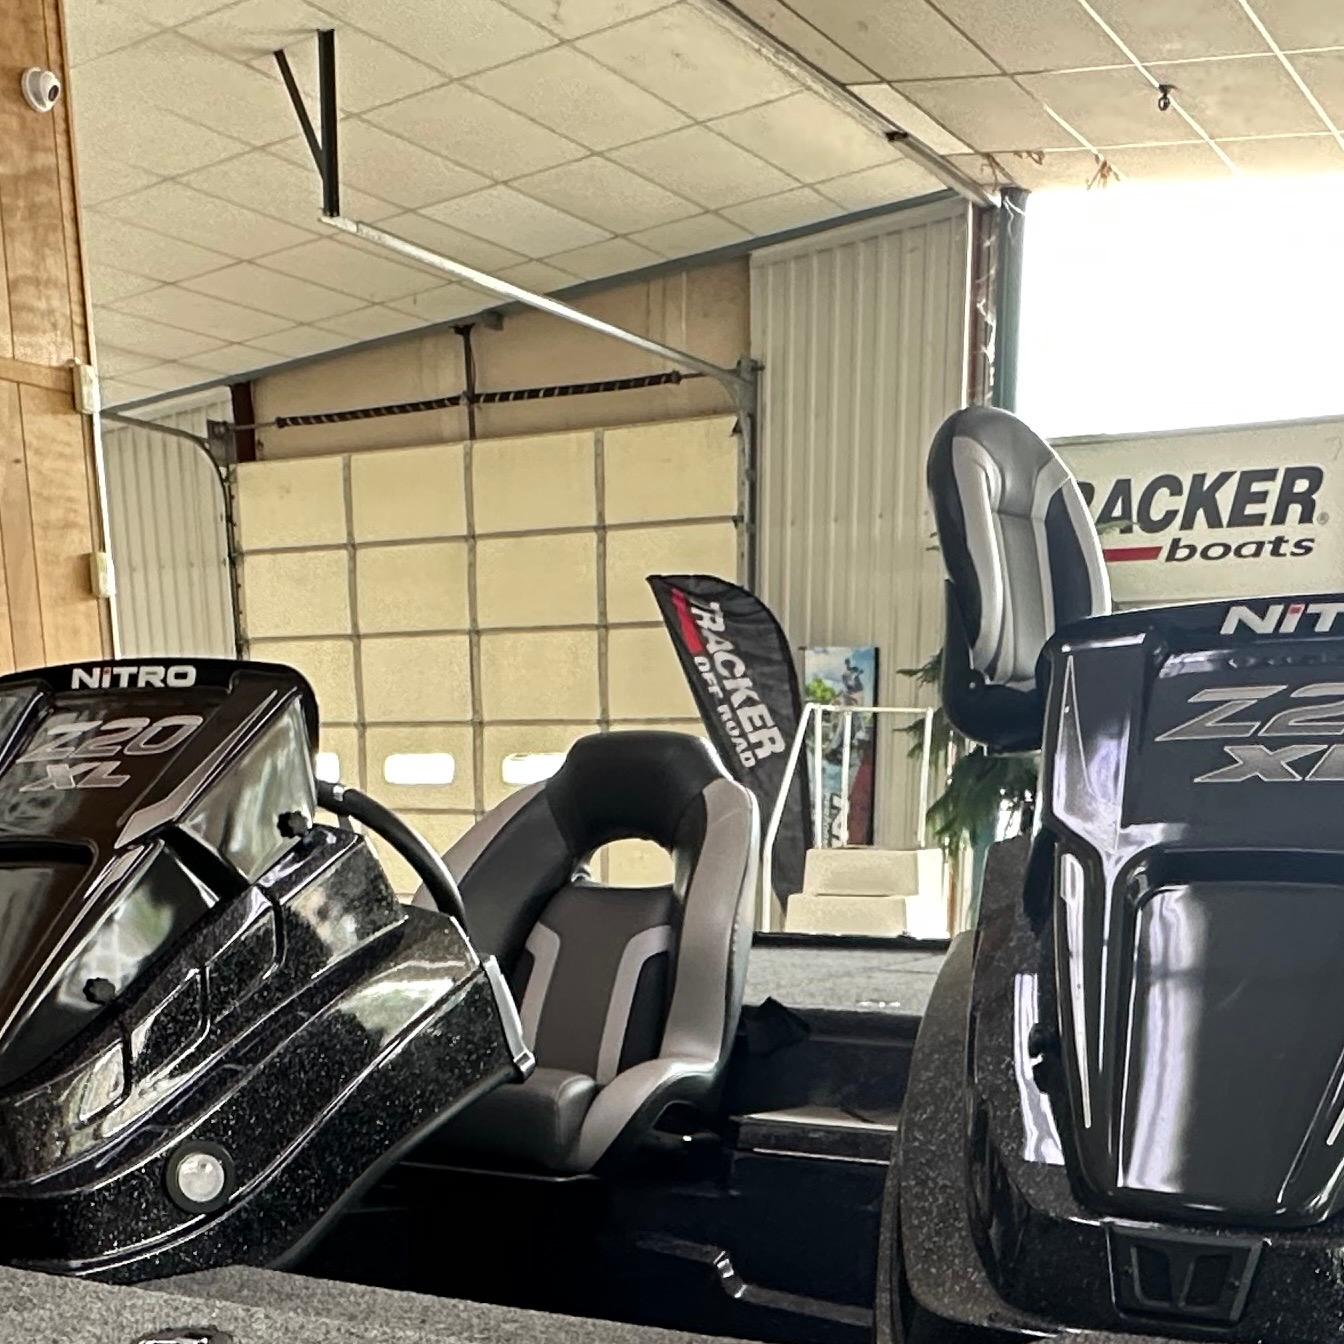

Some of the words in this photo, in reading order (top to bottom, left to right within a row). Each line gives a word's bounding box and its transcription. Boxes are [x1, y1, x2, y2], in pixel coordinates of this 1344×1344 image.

[1077, 465, 1324, 534] ACKER
[1164, 535, 1316, 563] boats
[691, 601, 786, 760] TRACKER
[16, 715, 204, 764] Z20
[694, 655, 724, 699] OFF
[717, 704, 756, 768] ROAD
[19, 760, 131, 793] XL
